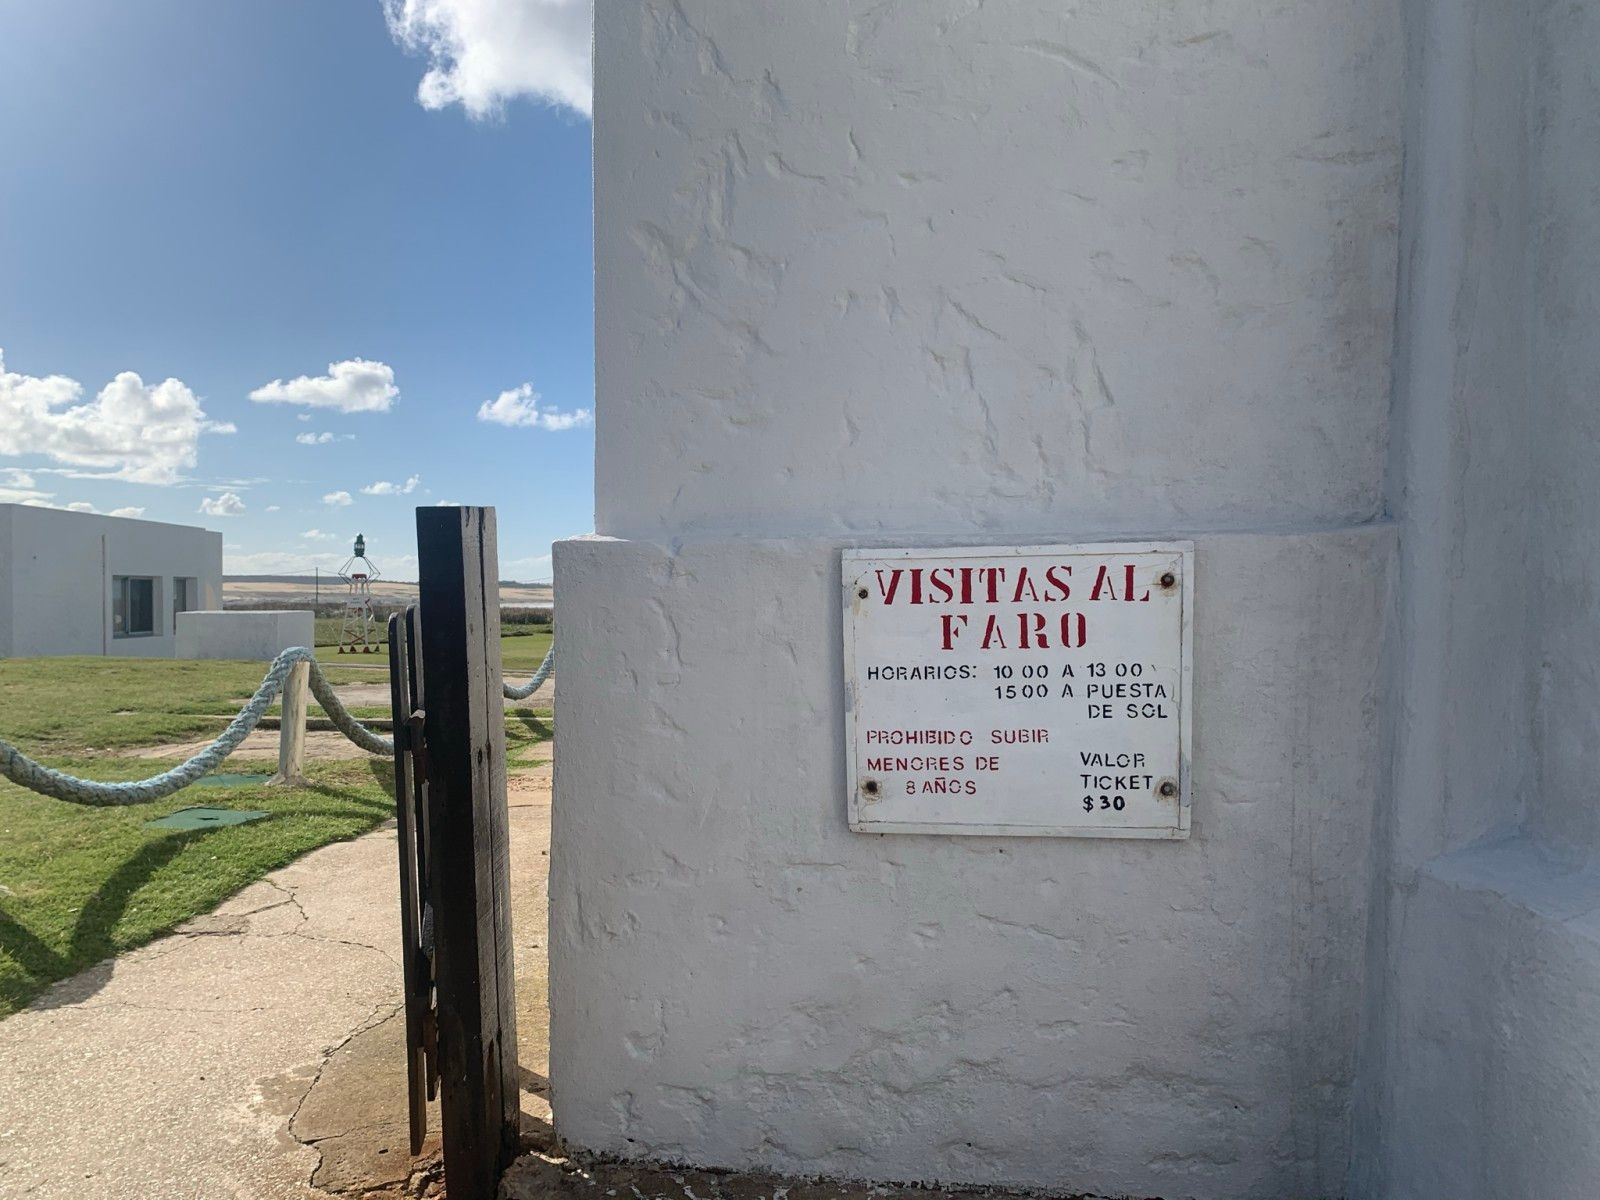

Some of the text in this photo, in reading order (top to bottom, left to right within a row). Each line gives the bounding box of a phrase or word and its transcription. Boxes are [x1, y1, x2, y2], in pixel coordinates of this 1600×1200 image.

[875, 564, 1150, 605] VISITAS AL
[940, 612, 1087, 650] FARO
[867, 665, 977, 680] HORARIOS:
[1062, 664, 1074, 678] A
[1062, 683, 1074, 698] A
[1087, 683, 1167, 699] PUESTA
[1088, 703, 1168, 719] DE SOL
[866, 729, 1049, 745] PROHIBIDO SUBIR
[867, 756, 1000, 772] MENORES DE
[1080, 751, 1145, 768] VALOR
[906, 777, 977, 795] 8 AÑOS
[1080, 774, 1154, 790] TICKET
